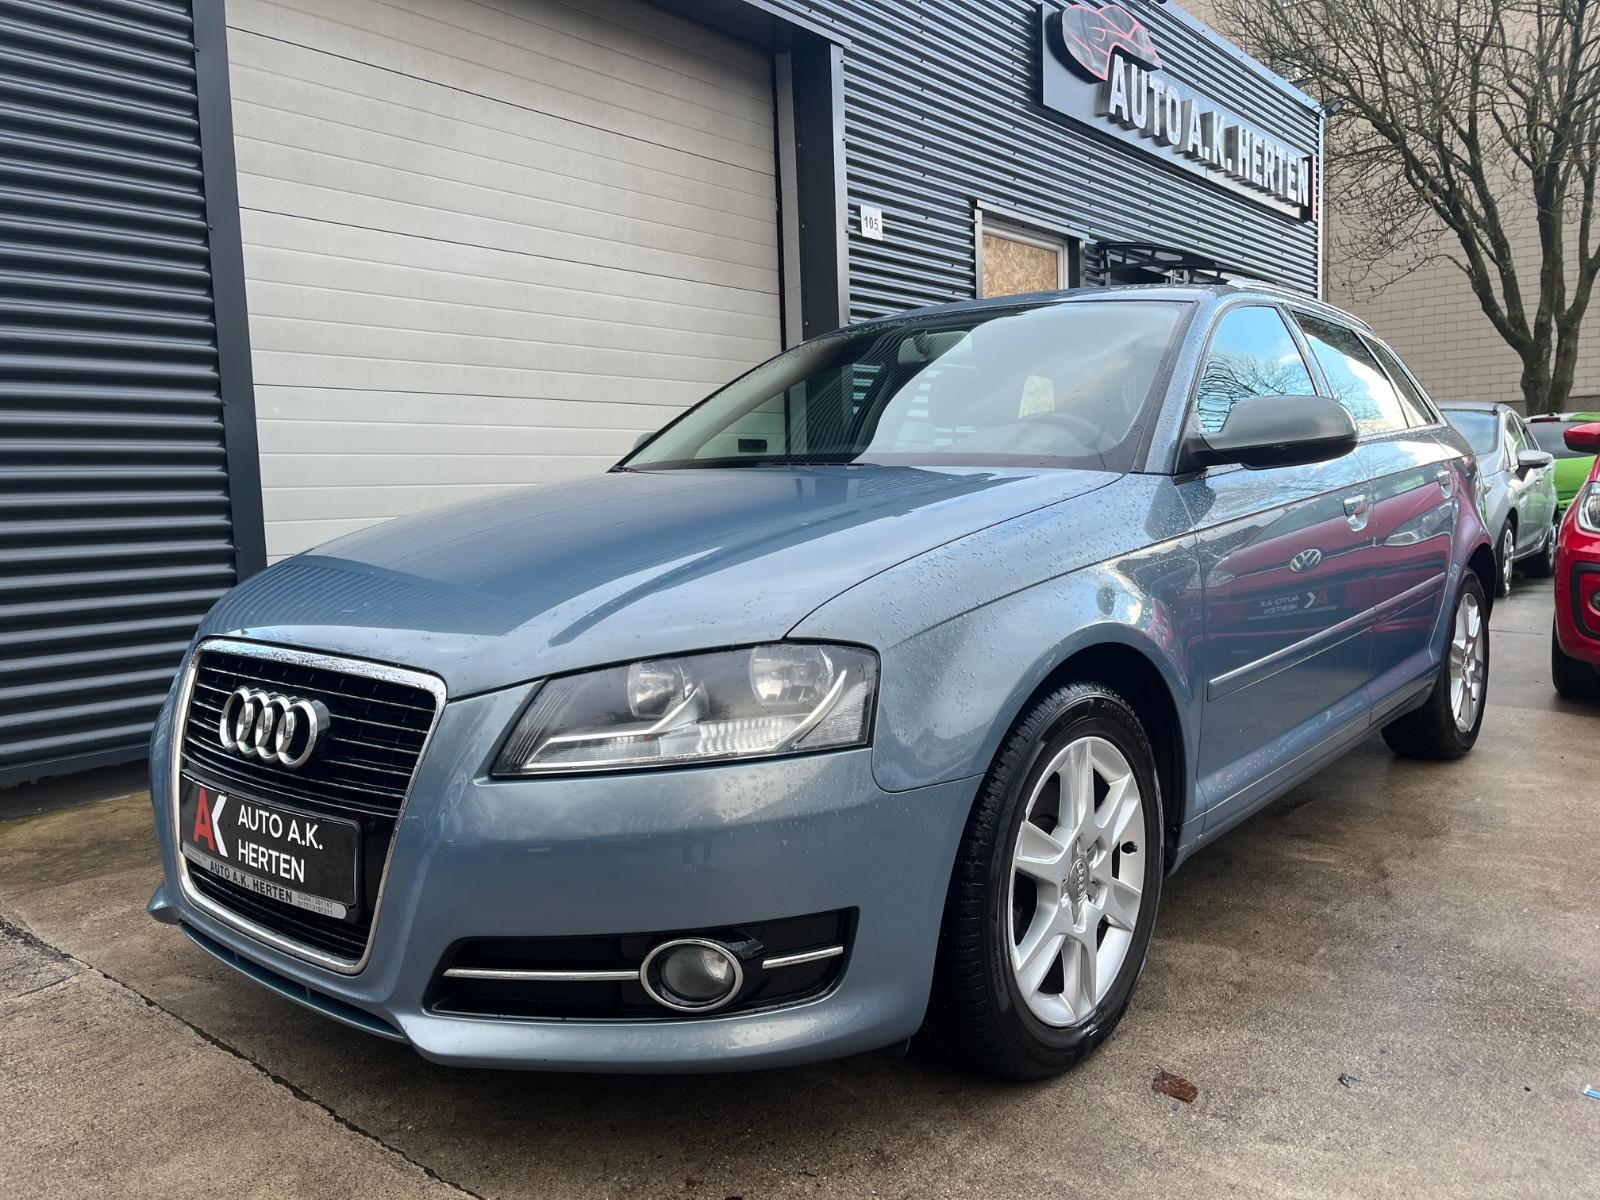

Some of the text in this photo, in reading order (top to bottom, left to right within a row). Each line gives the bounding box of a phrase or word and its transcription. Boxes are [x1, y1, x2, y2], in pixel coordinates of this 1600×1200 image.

[1108, 53, 1182, 146] AUTO
[1236, 125, 1309, 207] HERTEN
[864, 215, 879, 231] 105
[237, 804, 324, 850] AUTO A.K.
[210, 860, 293, 904] AUTO A.K. HERTEN
[237, 839, 305, 884] HERTEN
